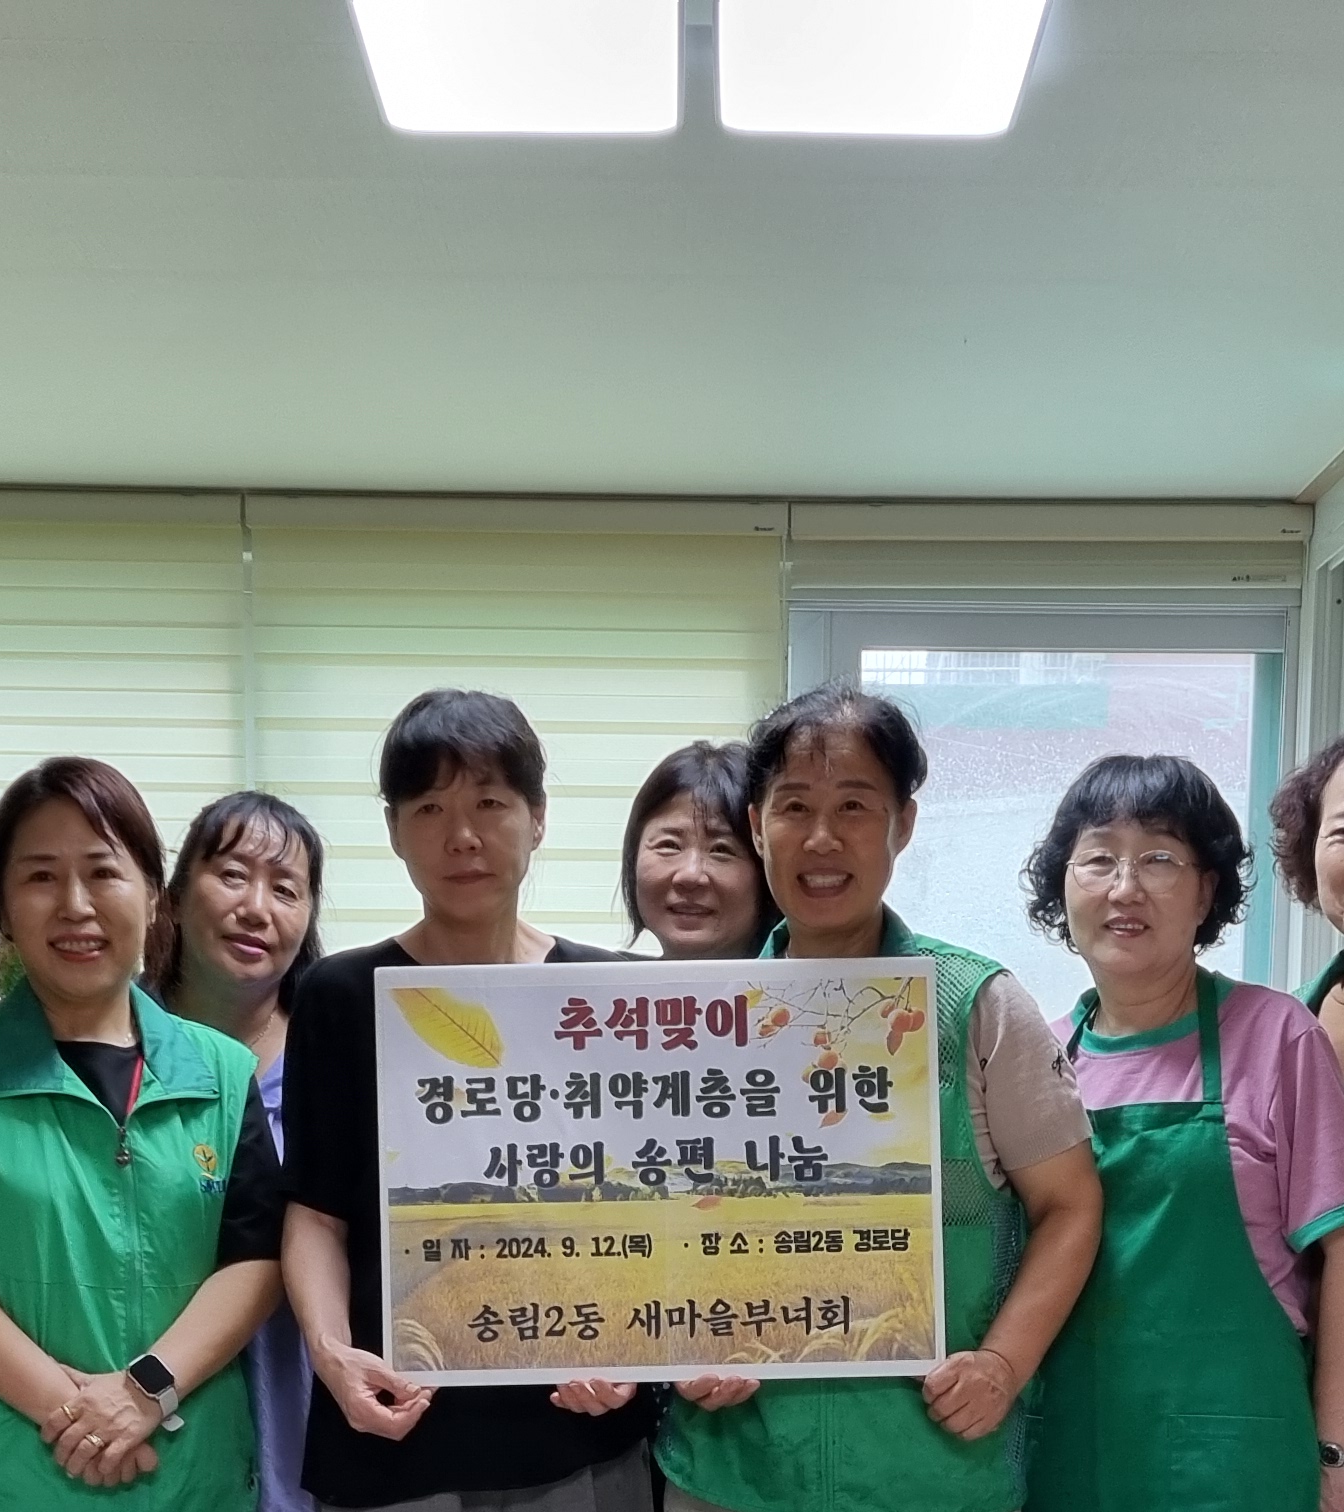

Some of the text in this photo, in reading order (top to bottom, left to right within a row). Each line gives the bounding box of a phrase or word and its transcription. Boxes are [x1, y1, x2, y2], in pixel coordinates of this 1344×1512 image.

[555, 995, 749, 1049] 추석맞이
[417, 1065, 893, 1124] 경로당·취약계층을 위한
[484, 1136, 828, 1187] 사랑의 송편 나눔
[496, 1237, 552, 1259] 2024.
[562, 1237, 581, 1258] 9.
[590, 1234, 653, 1259] 12.(목)
[774, 1230, 844, 1254] 송림2동
[853, 1228, 911, 1252] 경로당
[467, 1296, 853, 1343] 송림2동 새마을부녀회
